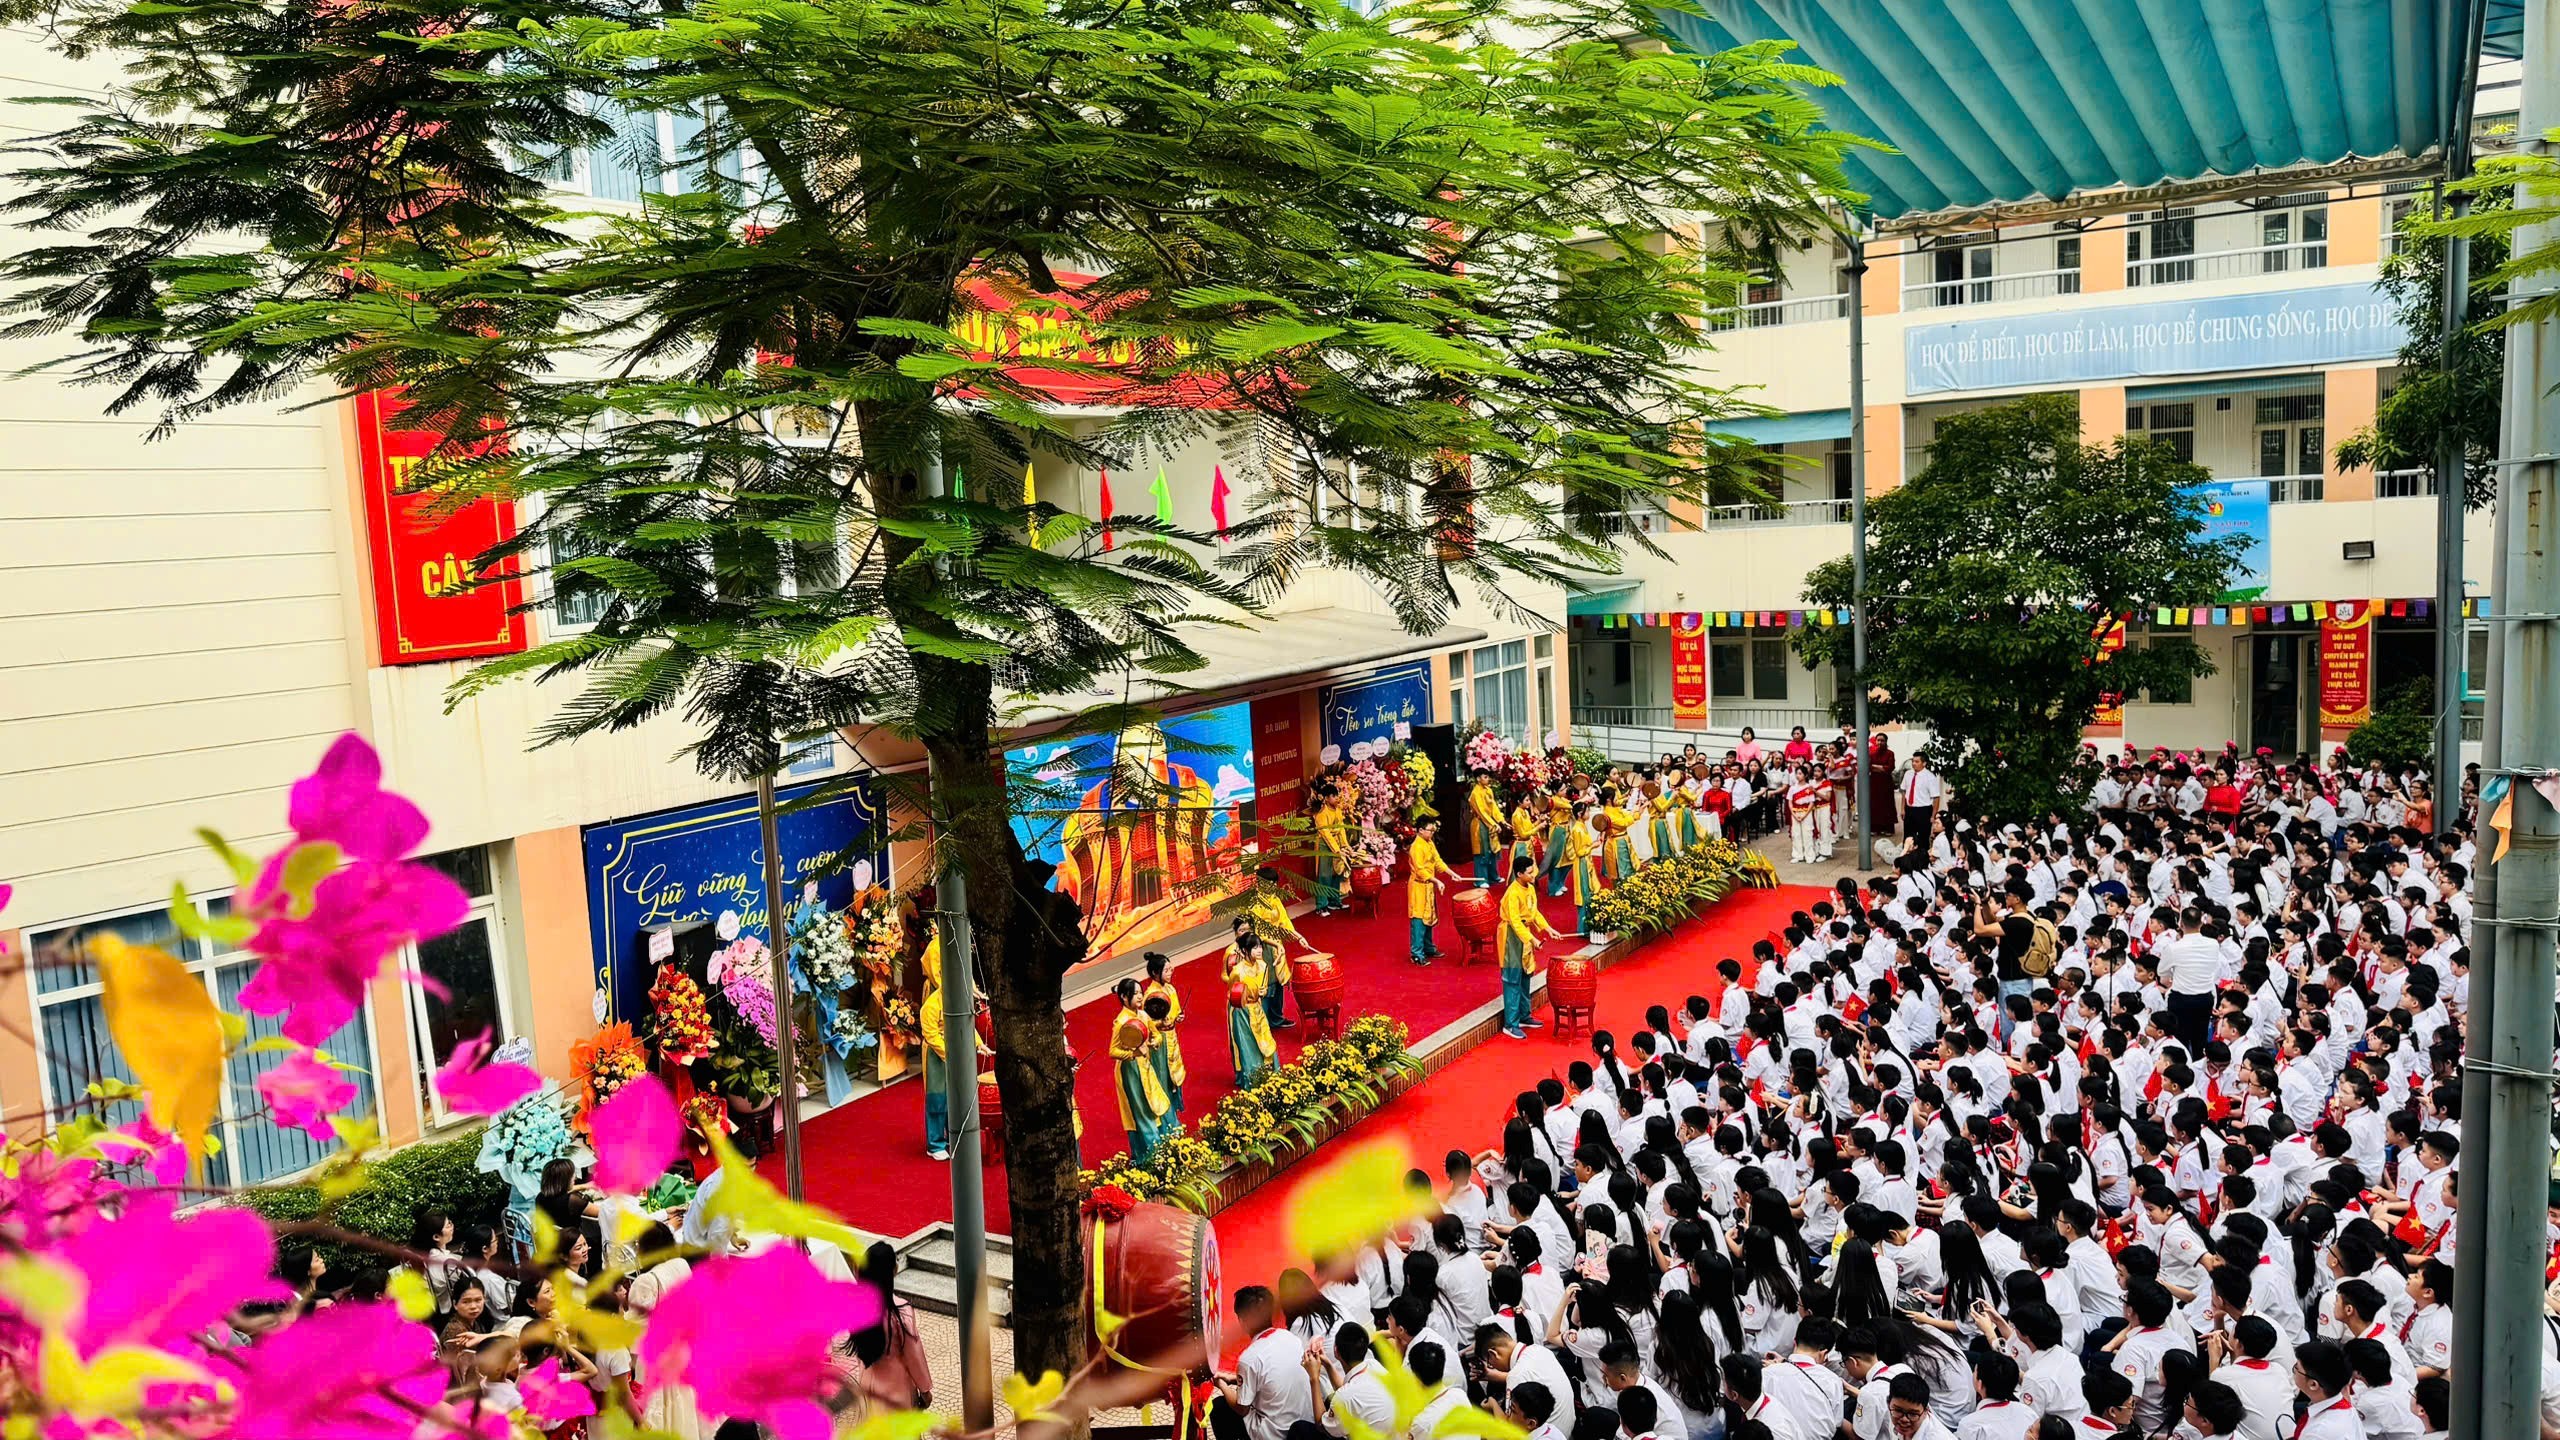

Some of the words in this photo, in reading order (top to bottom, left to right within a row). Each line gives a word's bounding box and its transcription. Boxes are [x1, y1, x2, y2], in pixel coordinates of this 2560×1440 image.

[1921, 342, 1954, 369] HỌC
[1958, 328, 1979, 363] ĐỂ
[1982, 325, 2022, 362] BIẾT,
[2024, 331, 2059, 362] HỌC
[2063, 317, 2084, 354] ĐỂ
[2088, 321, 2129, 352] LÀM,
[2132, 322, 2169, 352] HỌC
[2173, 308, 2196, 345] ĐỂ
[2200, 314, 2262, 344] CHUNG
[2266, 300, 2322, 338] SỐNG,
[2324, 304, 2366, 337] HỌC
